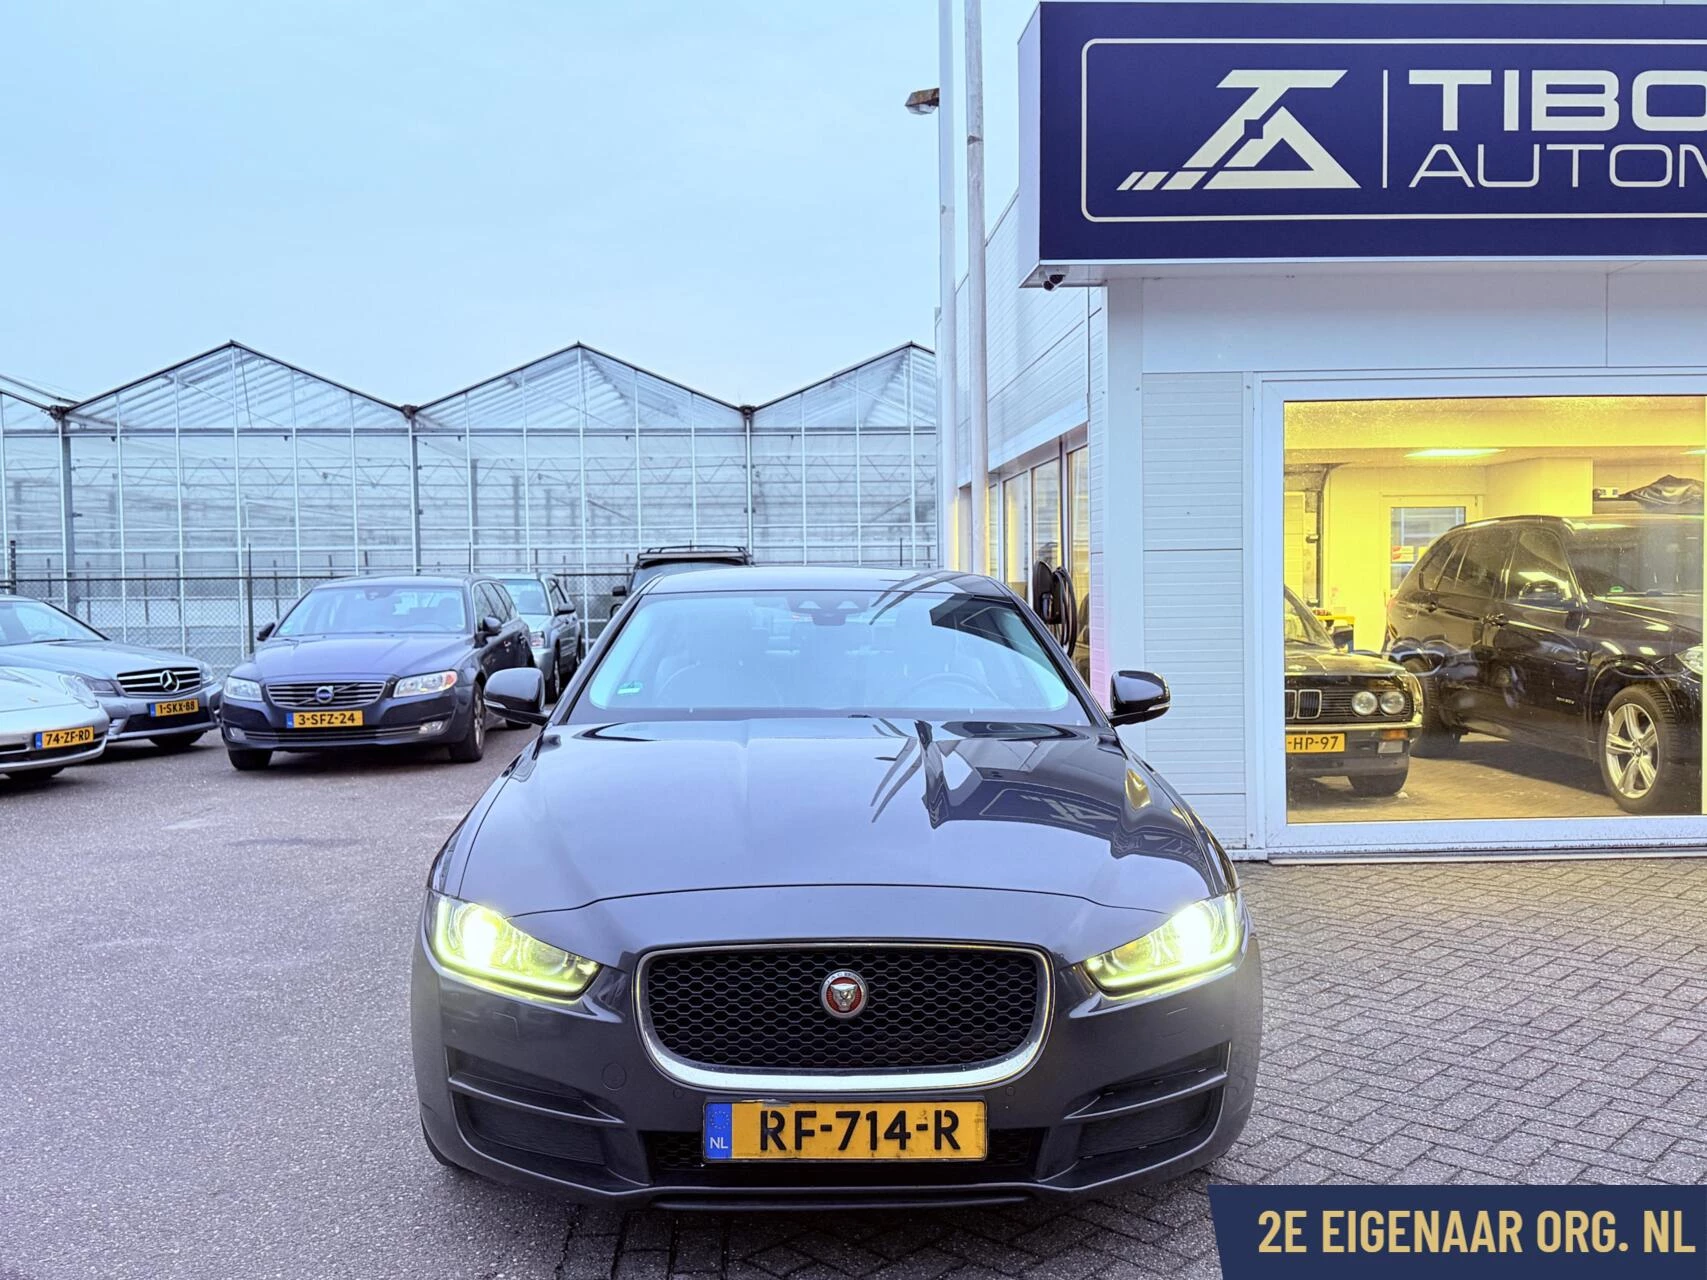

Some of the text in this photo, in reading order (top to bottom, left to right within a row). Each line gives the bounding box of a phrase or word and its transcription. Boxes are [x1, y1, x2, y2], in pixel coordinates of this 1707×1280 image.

[1408, 69, 1707, 132] TIBO
[298, 712, 355, 726] 3-SFZ-24
[45, 729, 91, 746] 74-ZF-RD
[759, 1109, 961, 1151] RF-714-R
[709, 1136, 729, 1150] NL
